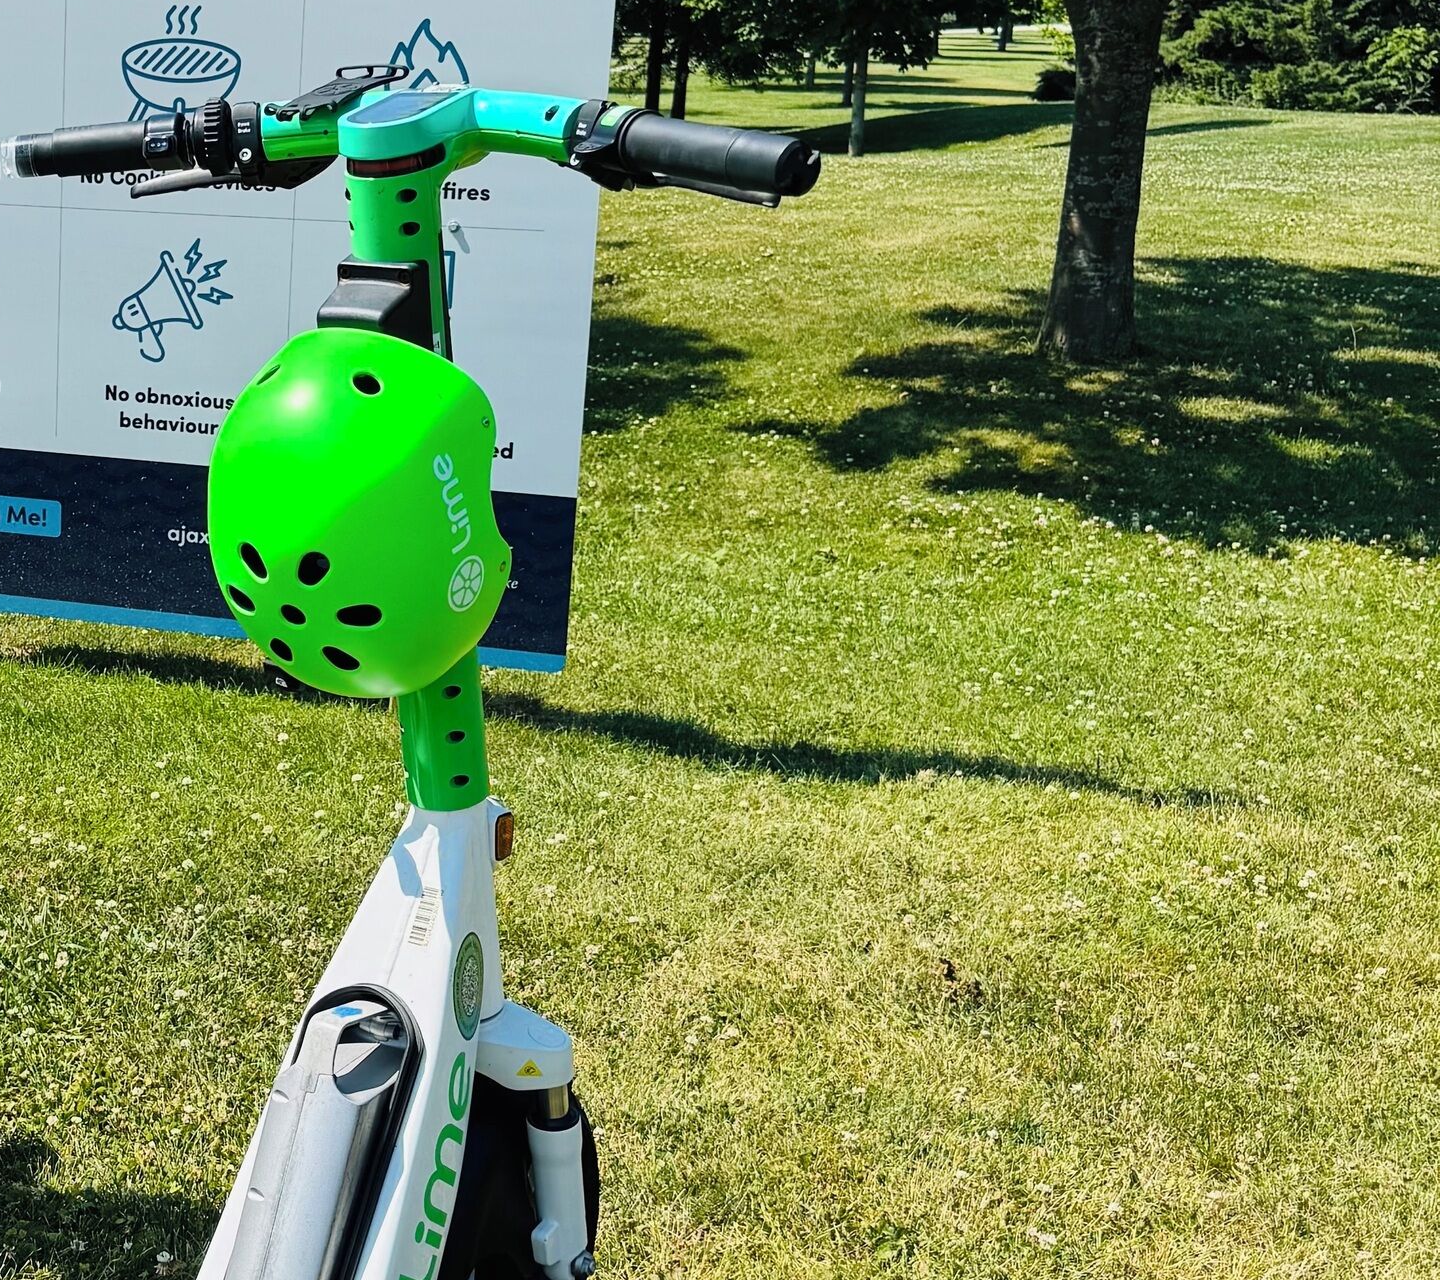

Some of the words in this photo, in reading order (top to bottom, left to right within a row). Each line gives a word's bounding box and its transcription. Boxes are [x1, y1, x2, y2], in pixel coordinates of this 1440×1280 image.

[105, 384, 129, 401] No
[135, 387, 235, 410] obnoxious
[119, 411, 219, 435] behaviour
[6, 505, 47, 527] Me!
[433, 453, 472, 555] Lime
